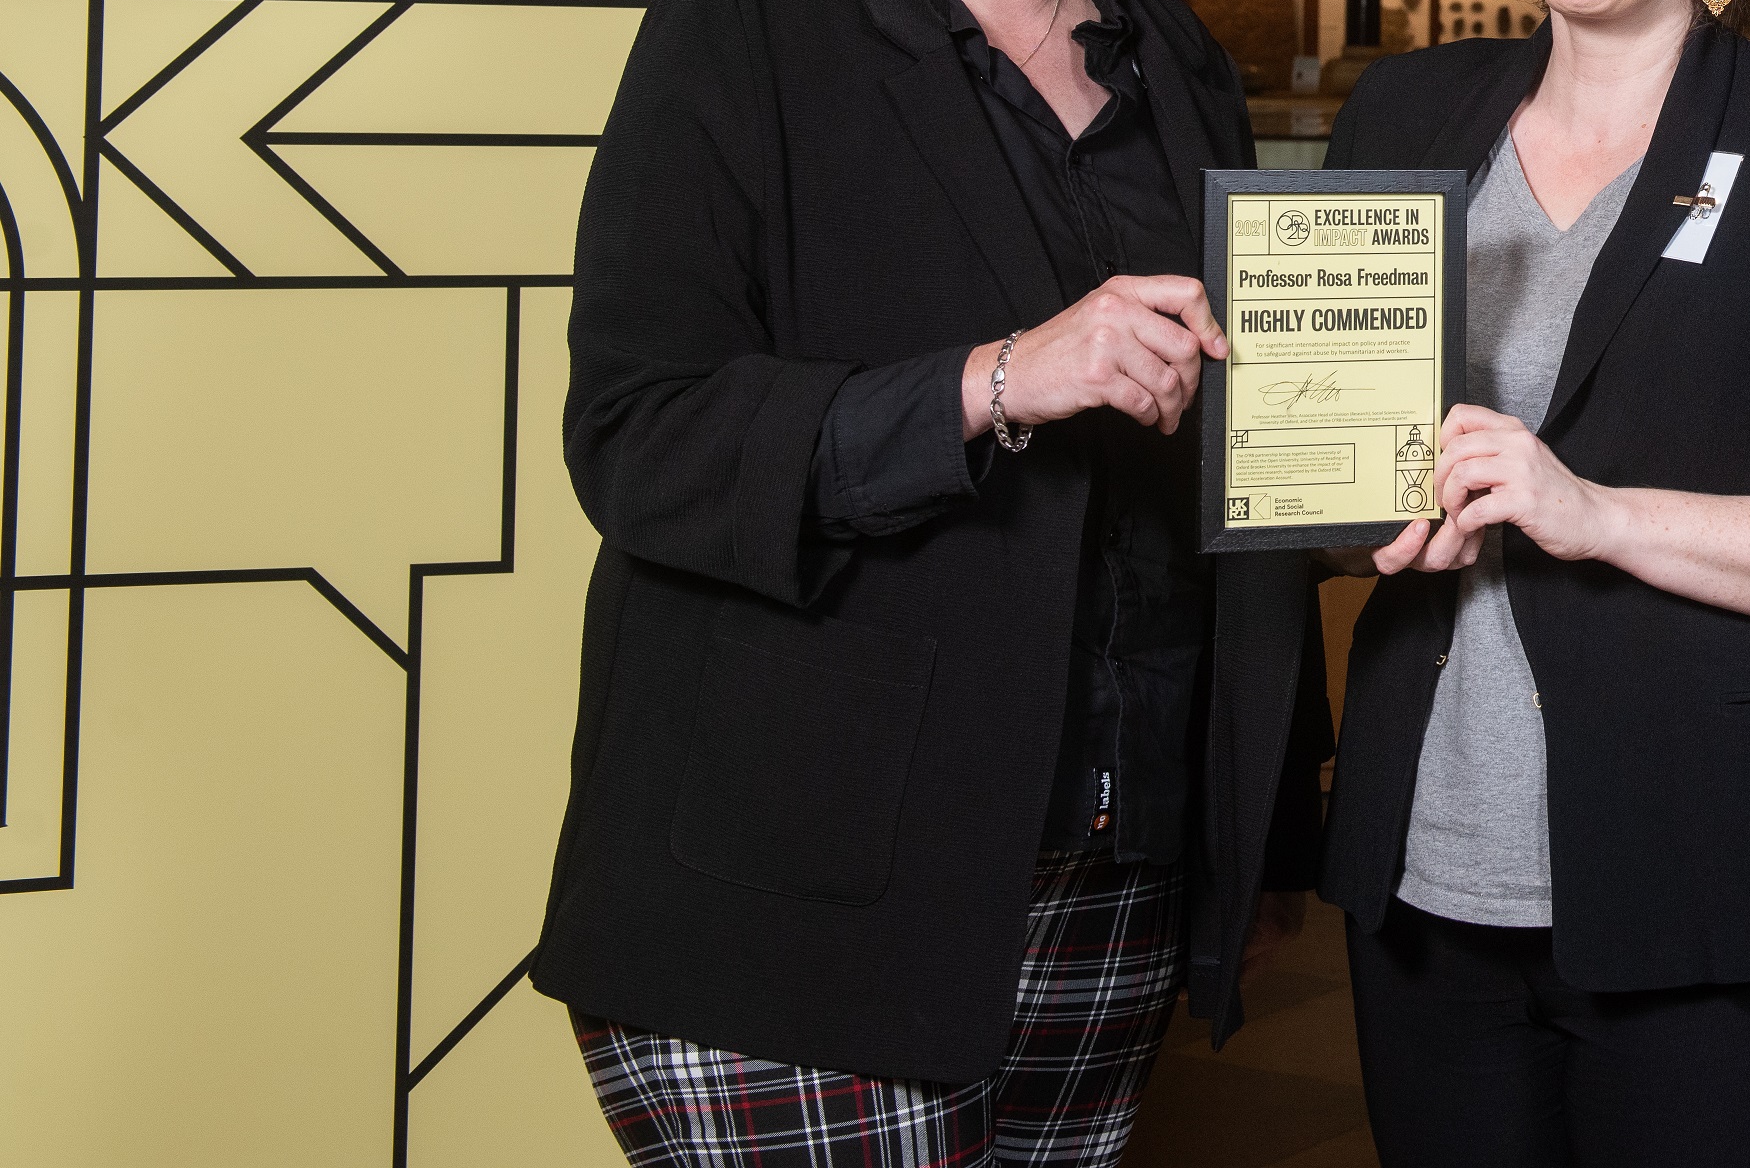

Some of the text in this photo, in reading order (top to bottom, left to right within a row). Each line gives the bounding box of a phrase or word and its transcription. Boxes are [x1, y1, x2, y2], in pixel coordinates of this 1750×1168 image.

[1315, 209, 1419, 226] EXCELLENCE IN
[1235, 220, 1267, 237] 2021
[1314, 229, 1429, 247] IMPACT AWARDS
[1239, 268, 1428, 288] Professor Rosa Freedman
[1241, 307, 1427, 334] HIGHLY COMMENDED
[1229, 499, 1247, 511] UK
[1100, 772, 1111, 809] labels
